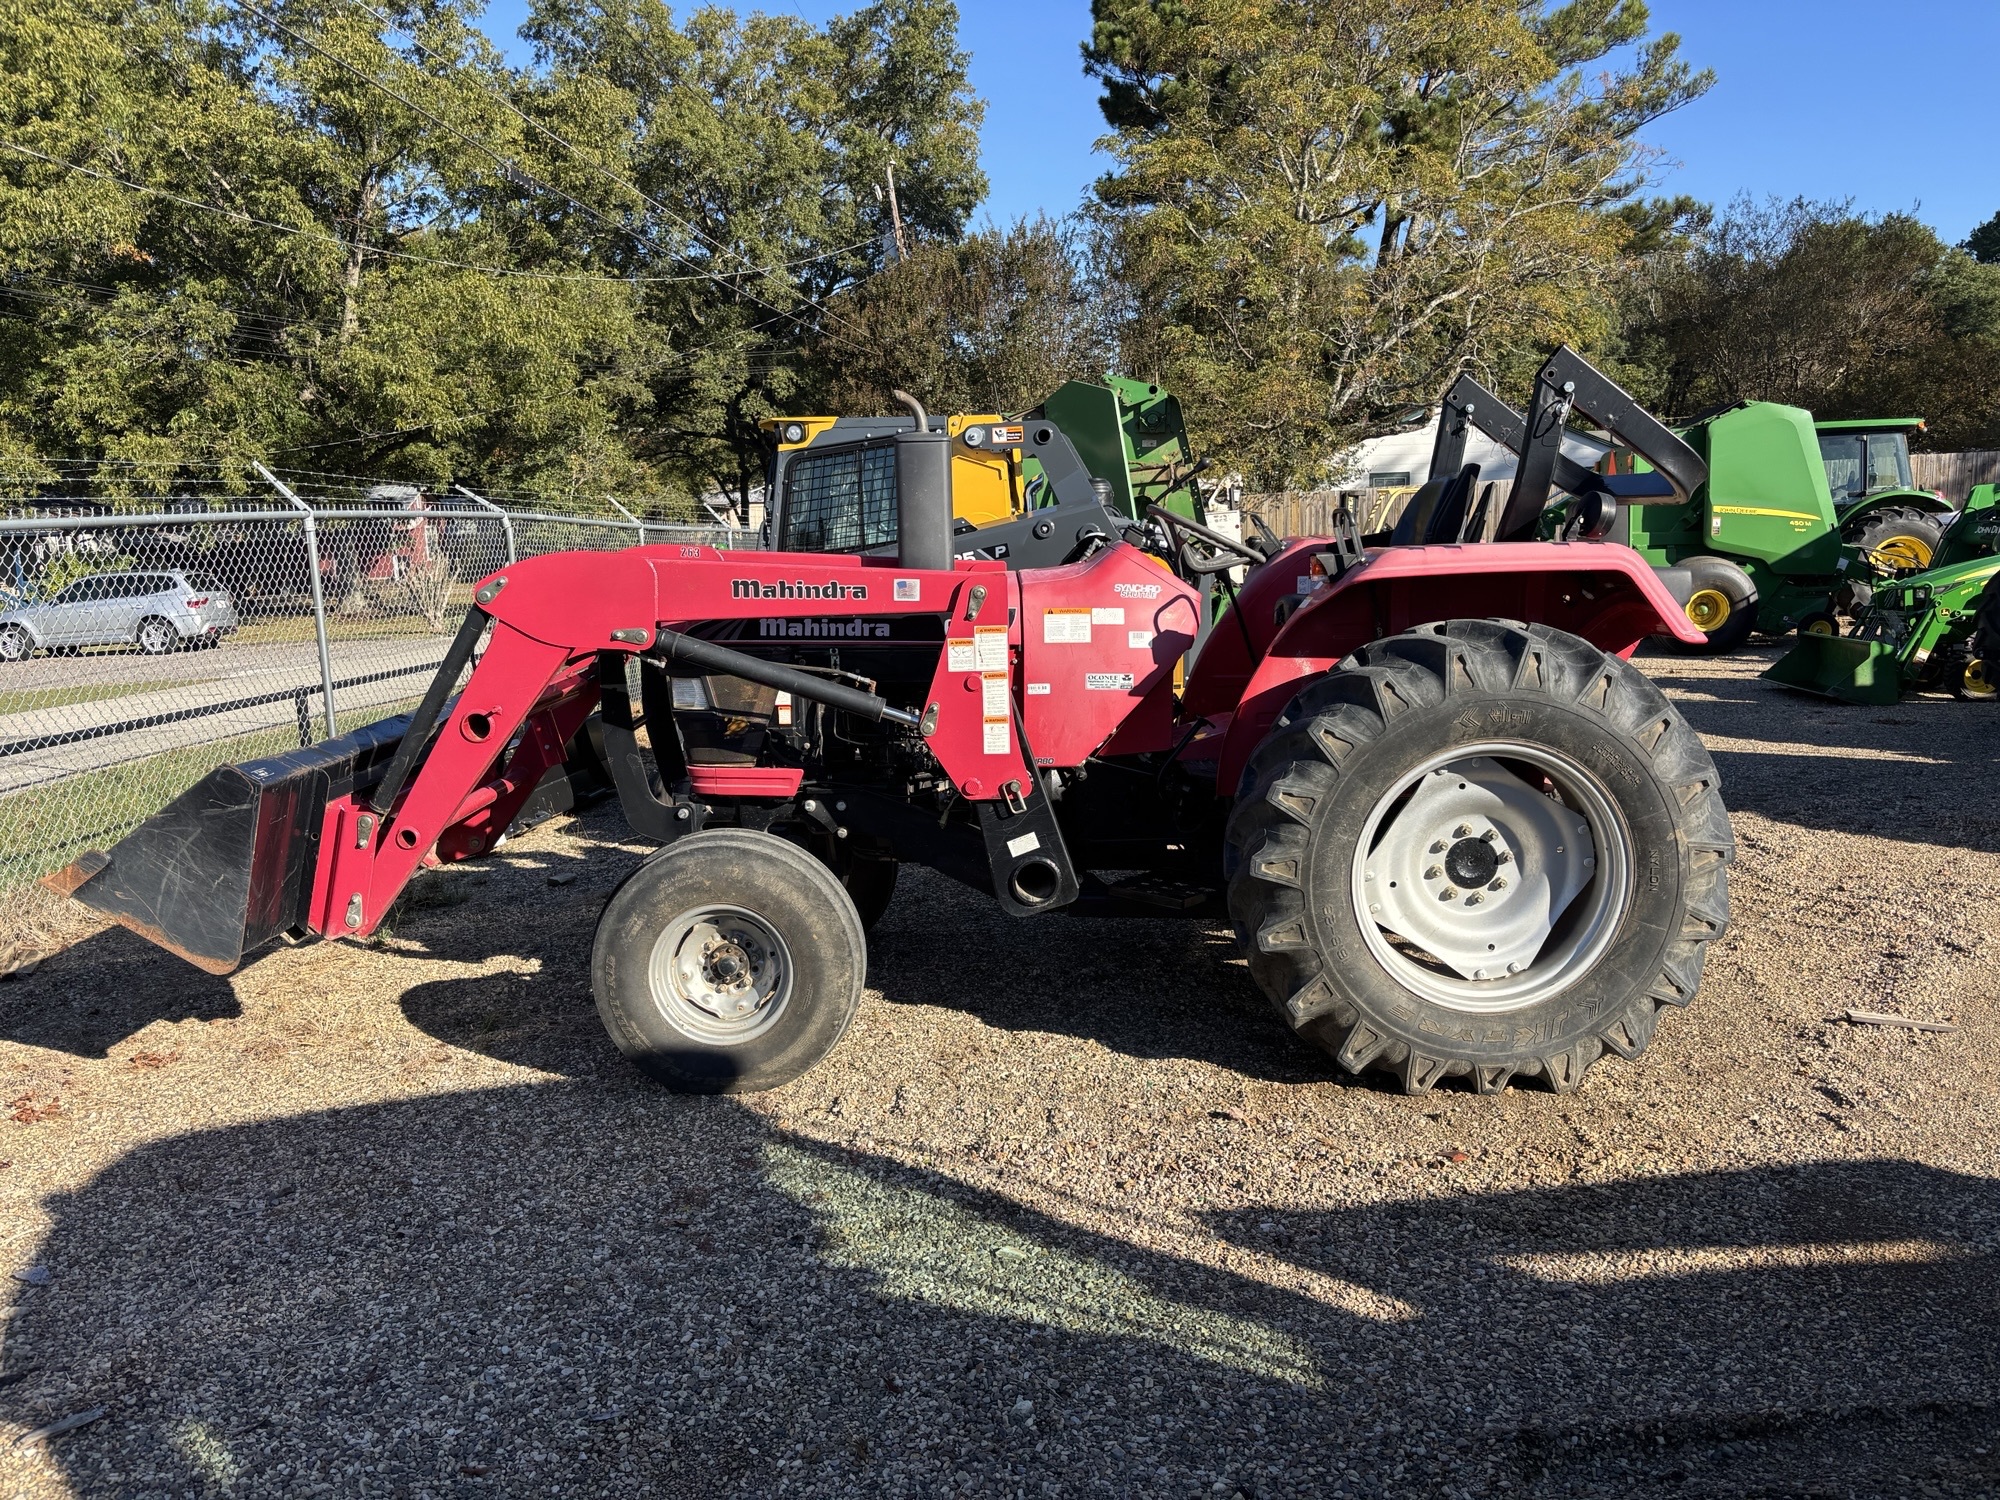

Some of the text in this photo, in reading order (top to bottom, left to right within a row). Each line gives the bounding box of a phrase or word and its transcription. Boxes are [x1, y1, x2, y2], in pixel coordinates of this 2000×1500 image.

[681, 547, 701, 558] 263
[995, 545, 1006, 558] P
[731, 579, 868, 600] Mahindra
[1114, 583, 1162, 593] SYNCHRO
[1120, 590, 1157, 599] SHUTTLE
[760, 618, 890, 637] Mahindra
[1035, 757, 1055, 765] RBO
[1591, 743, 1622, 770] DOUBLE
[1598, 739, 1621, 760] FIELD
[1622, 763, 1642, 786] ROAD
[1649, 850, 1660, 892] NYLON
